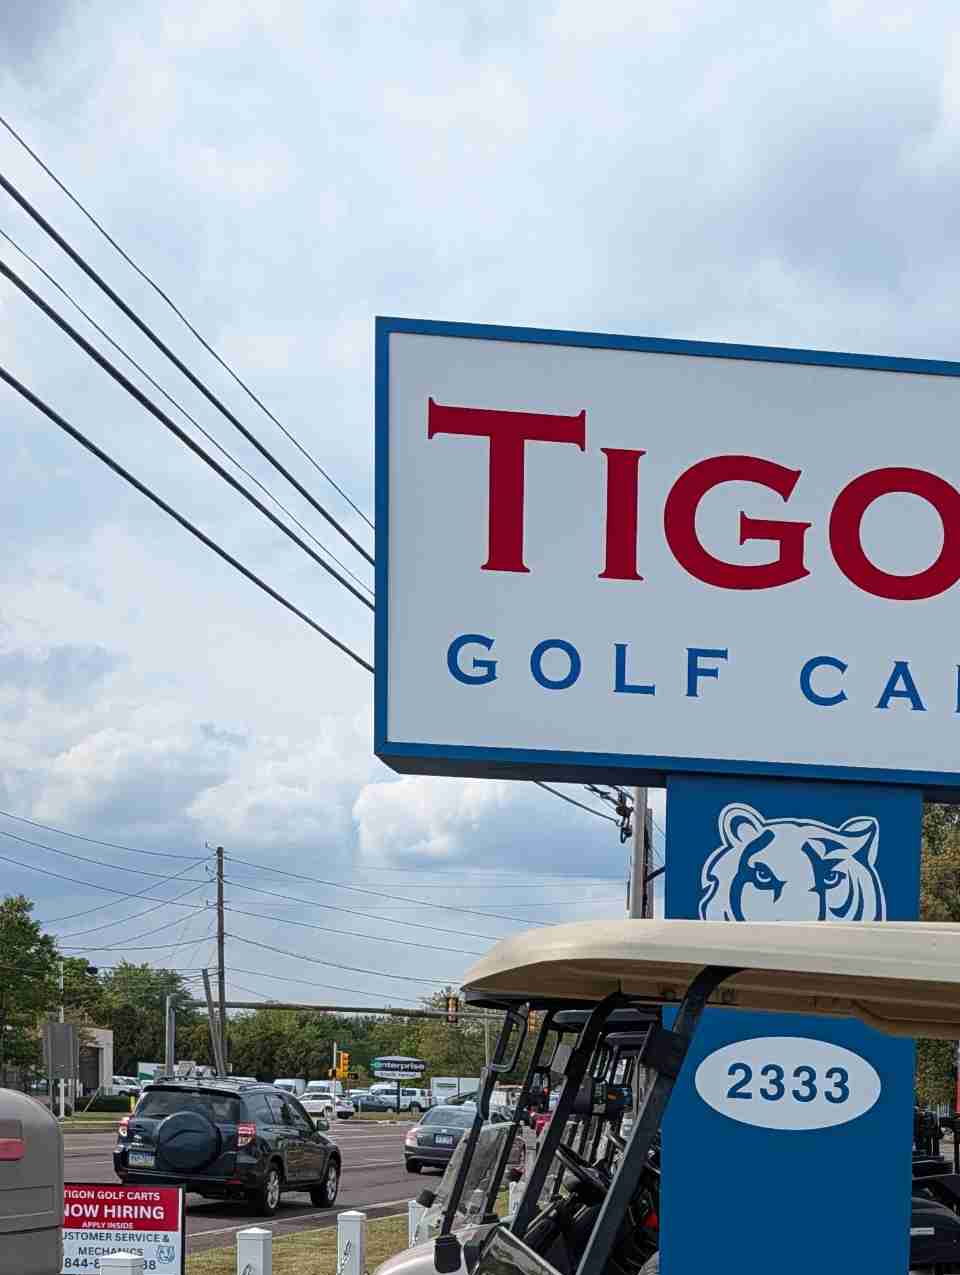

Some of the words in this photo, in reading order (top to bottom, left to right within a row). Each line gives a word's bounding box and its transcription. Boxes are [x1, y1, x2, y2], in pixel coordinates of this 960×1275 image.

[446, 633, 729, 698] GOLF
[726, 1062, 850, 1104] 2333
[97, 1191, 125, 1200] GOLF
[127, 1192, 160, 1201] CARTS
[64, 1203, 99, 1218] NOW
[104, 1204, 164, 1220] HIRING
[81, 1221, 106, 1229] APPLY
[64, 1231, 112, 1241] STOMER
[115, 1232, 160, 1242] SERVICE
